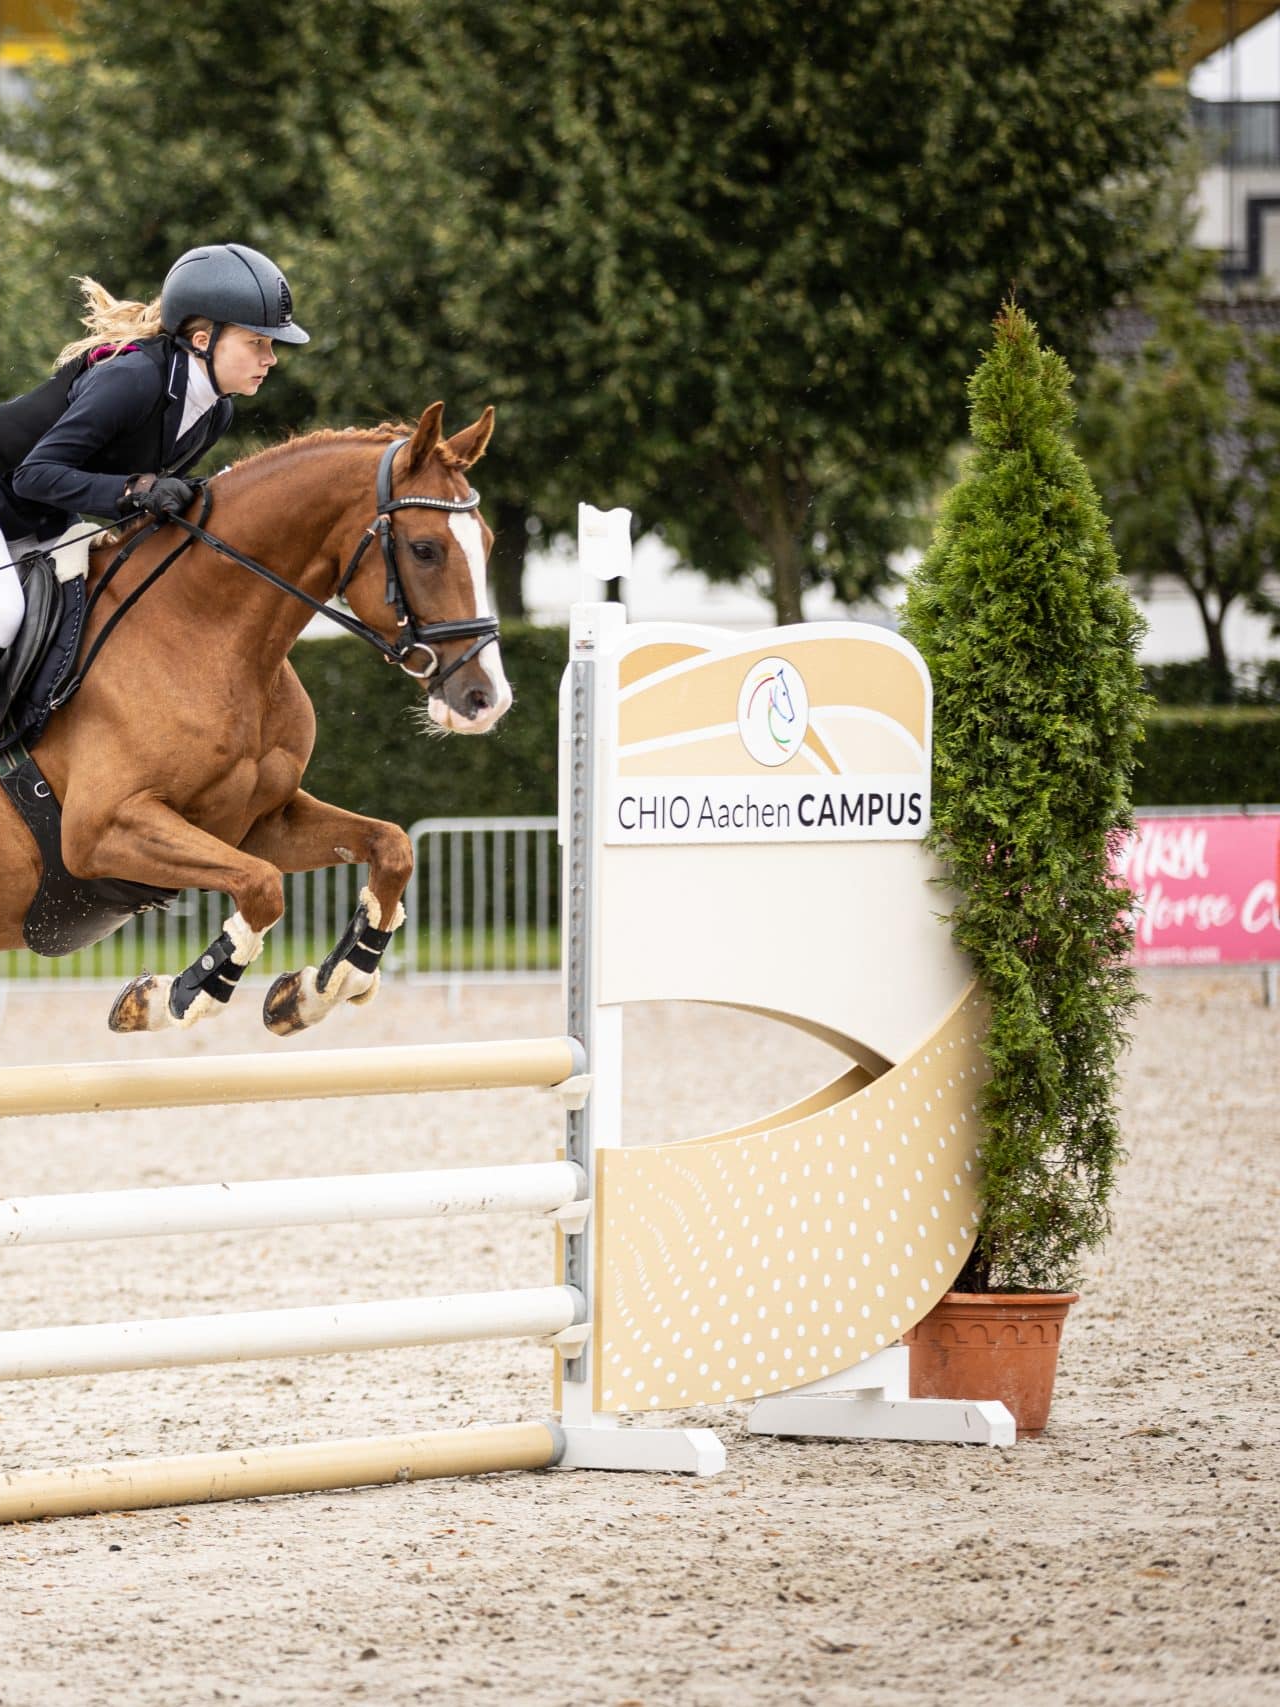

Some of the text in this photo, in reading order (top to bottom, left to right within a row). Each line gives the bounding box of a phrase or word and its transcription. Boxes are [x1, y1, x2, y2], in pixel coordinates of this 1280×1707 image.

[618, 792, 922, 830] CHIO Aachen CAMPUS
